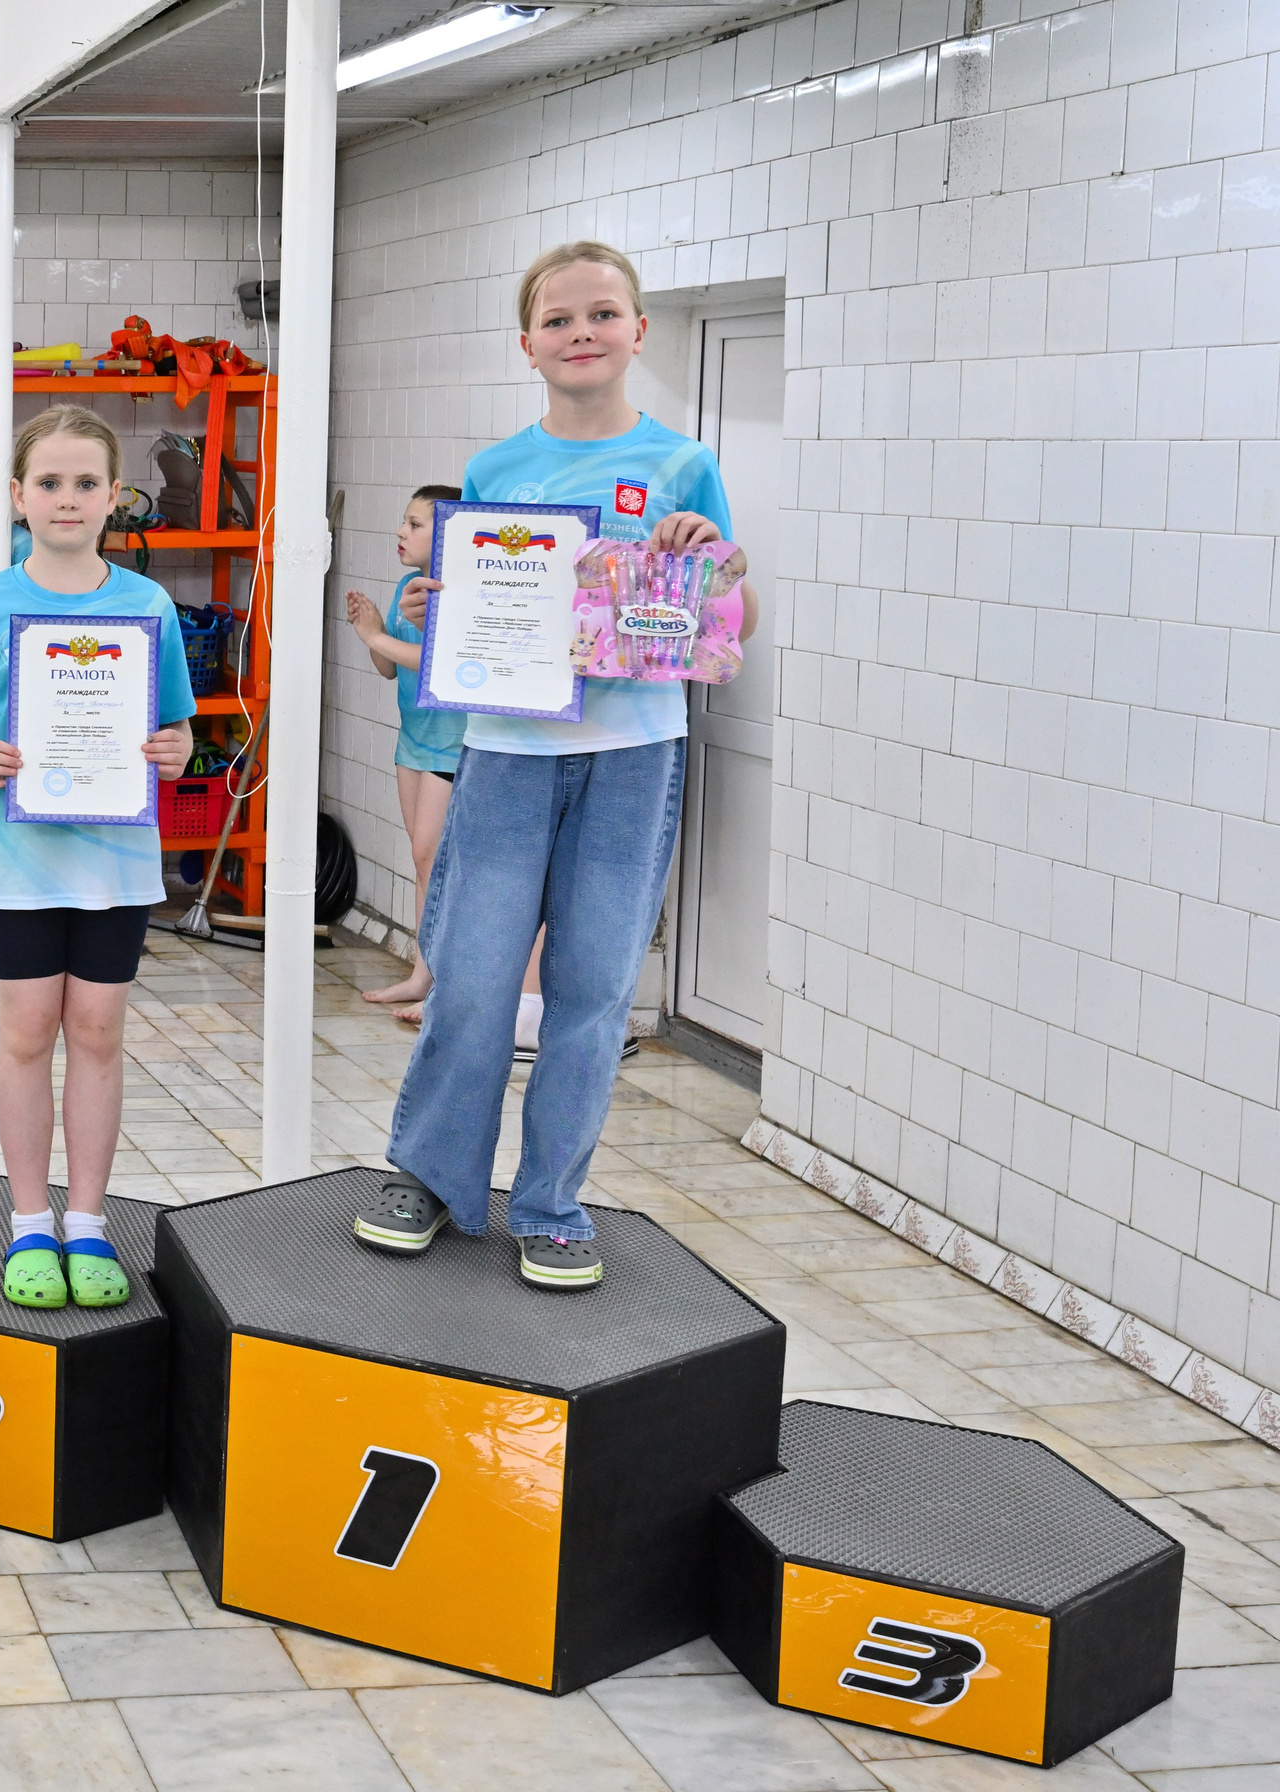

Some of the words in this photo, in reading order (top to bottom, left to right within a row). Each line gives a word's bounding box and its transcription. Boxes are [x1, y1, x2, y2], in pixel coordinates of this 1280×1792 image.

[600, 535, 640, 544] ЕКАТЕР
[476, 558, 548, 572] ГРАМОТА
[630, 607, 684, 619] Tattoo
[51, 670, 116, 680] ГРАМОТА
[334, 1445, 440, 1570] 1
[837, 1616, 986, 1707] 3
